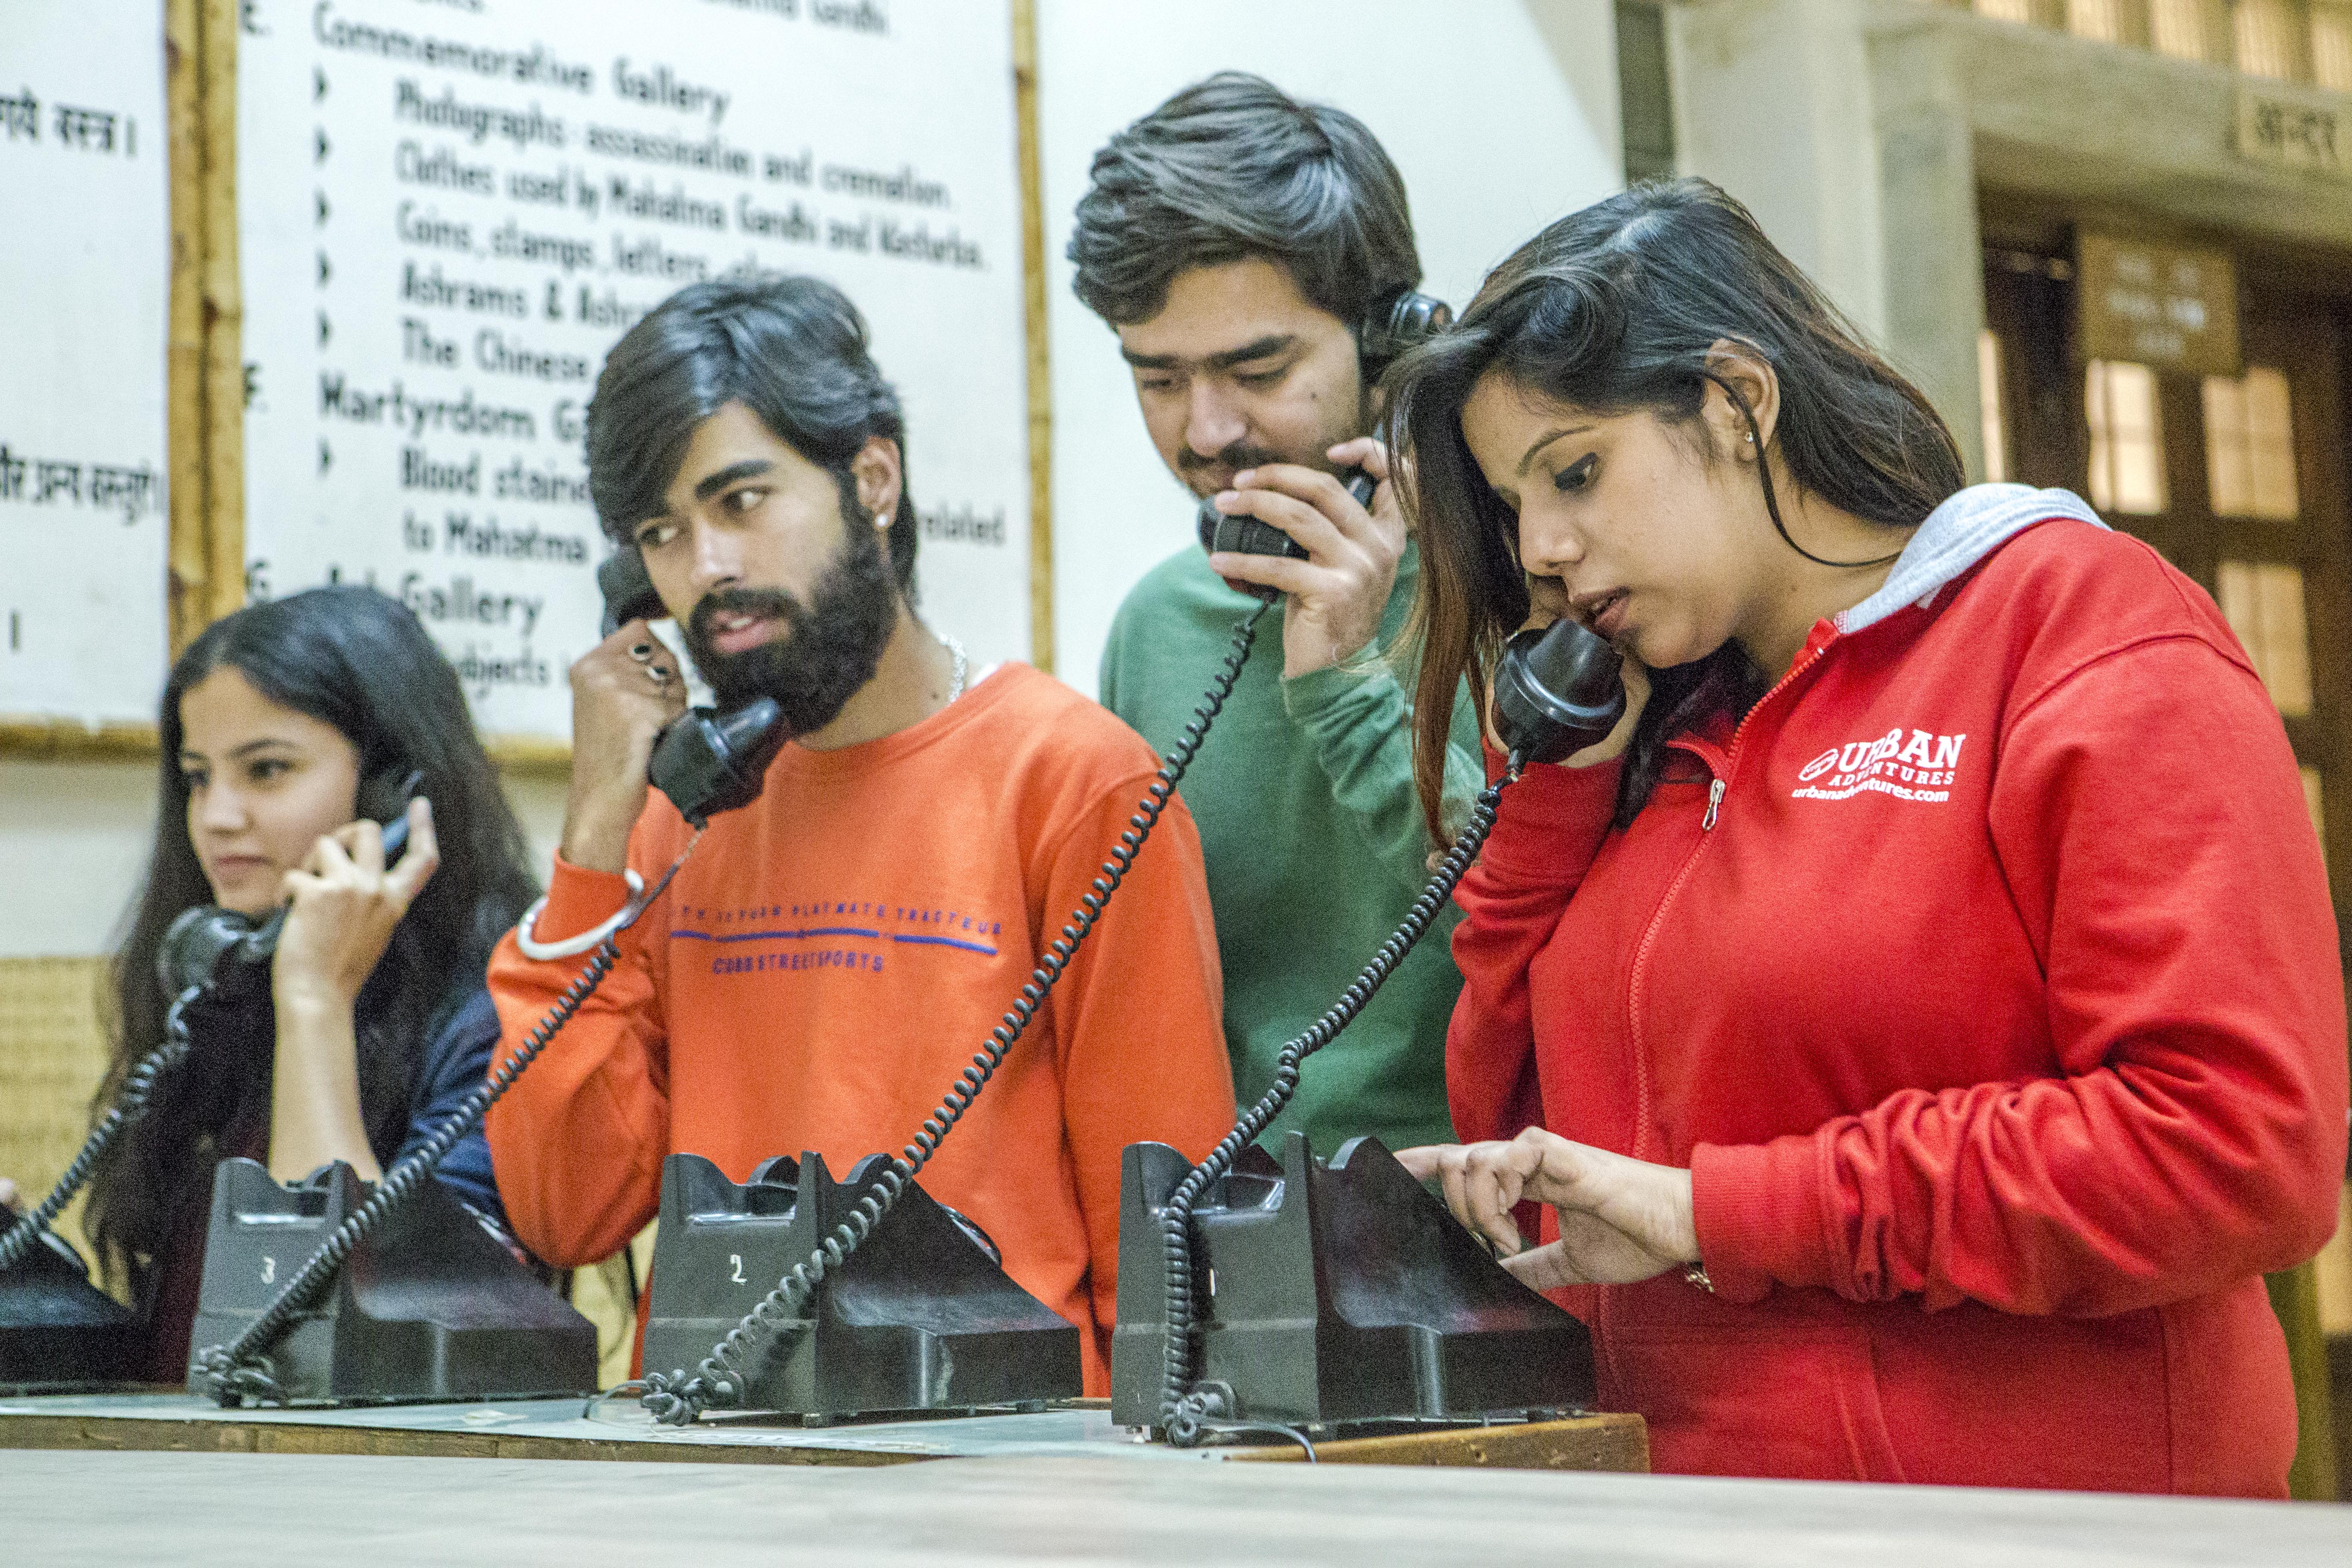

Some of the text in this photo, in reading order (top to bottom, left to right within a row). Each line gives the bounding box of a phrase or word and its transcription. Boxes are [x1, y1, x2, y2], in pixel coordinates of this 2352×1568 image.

[313, 0, 594, 95] Commemorative
[613, 57, 730, 125] Gallery
[763, 147, 812, 188] and
[395, 138, 496, 196] Clothes
[507, 164, 568, 205] used
[576, 164, 600, 221] by
[607, 173, 727, 232] Mahatma
[734, 192, 818, 243] Gandhi
[827, 215, 871, 255] and
[400, 258, 529, 319] Ashrams
[543, 279, 564, 321] &
[400, 314, 589, 383] The Chinese
[317, 372, 536, 437] Martyrdom
[400, 446, 481, 495] Blood
[401, 510, 588, 564] to Mahatma
[401, 572, 545, 637] Gallery
[1828, 761, 1955, 786] ADVENTURES
[1838, 729, 1966, 772] URBAN
[1792, 778, 1950, 802] urbanadventures.com
[261, 1256, 276, 1284] 3
[730, 1254, 748, 1286] 2
